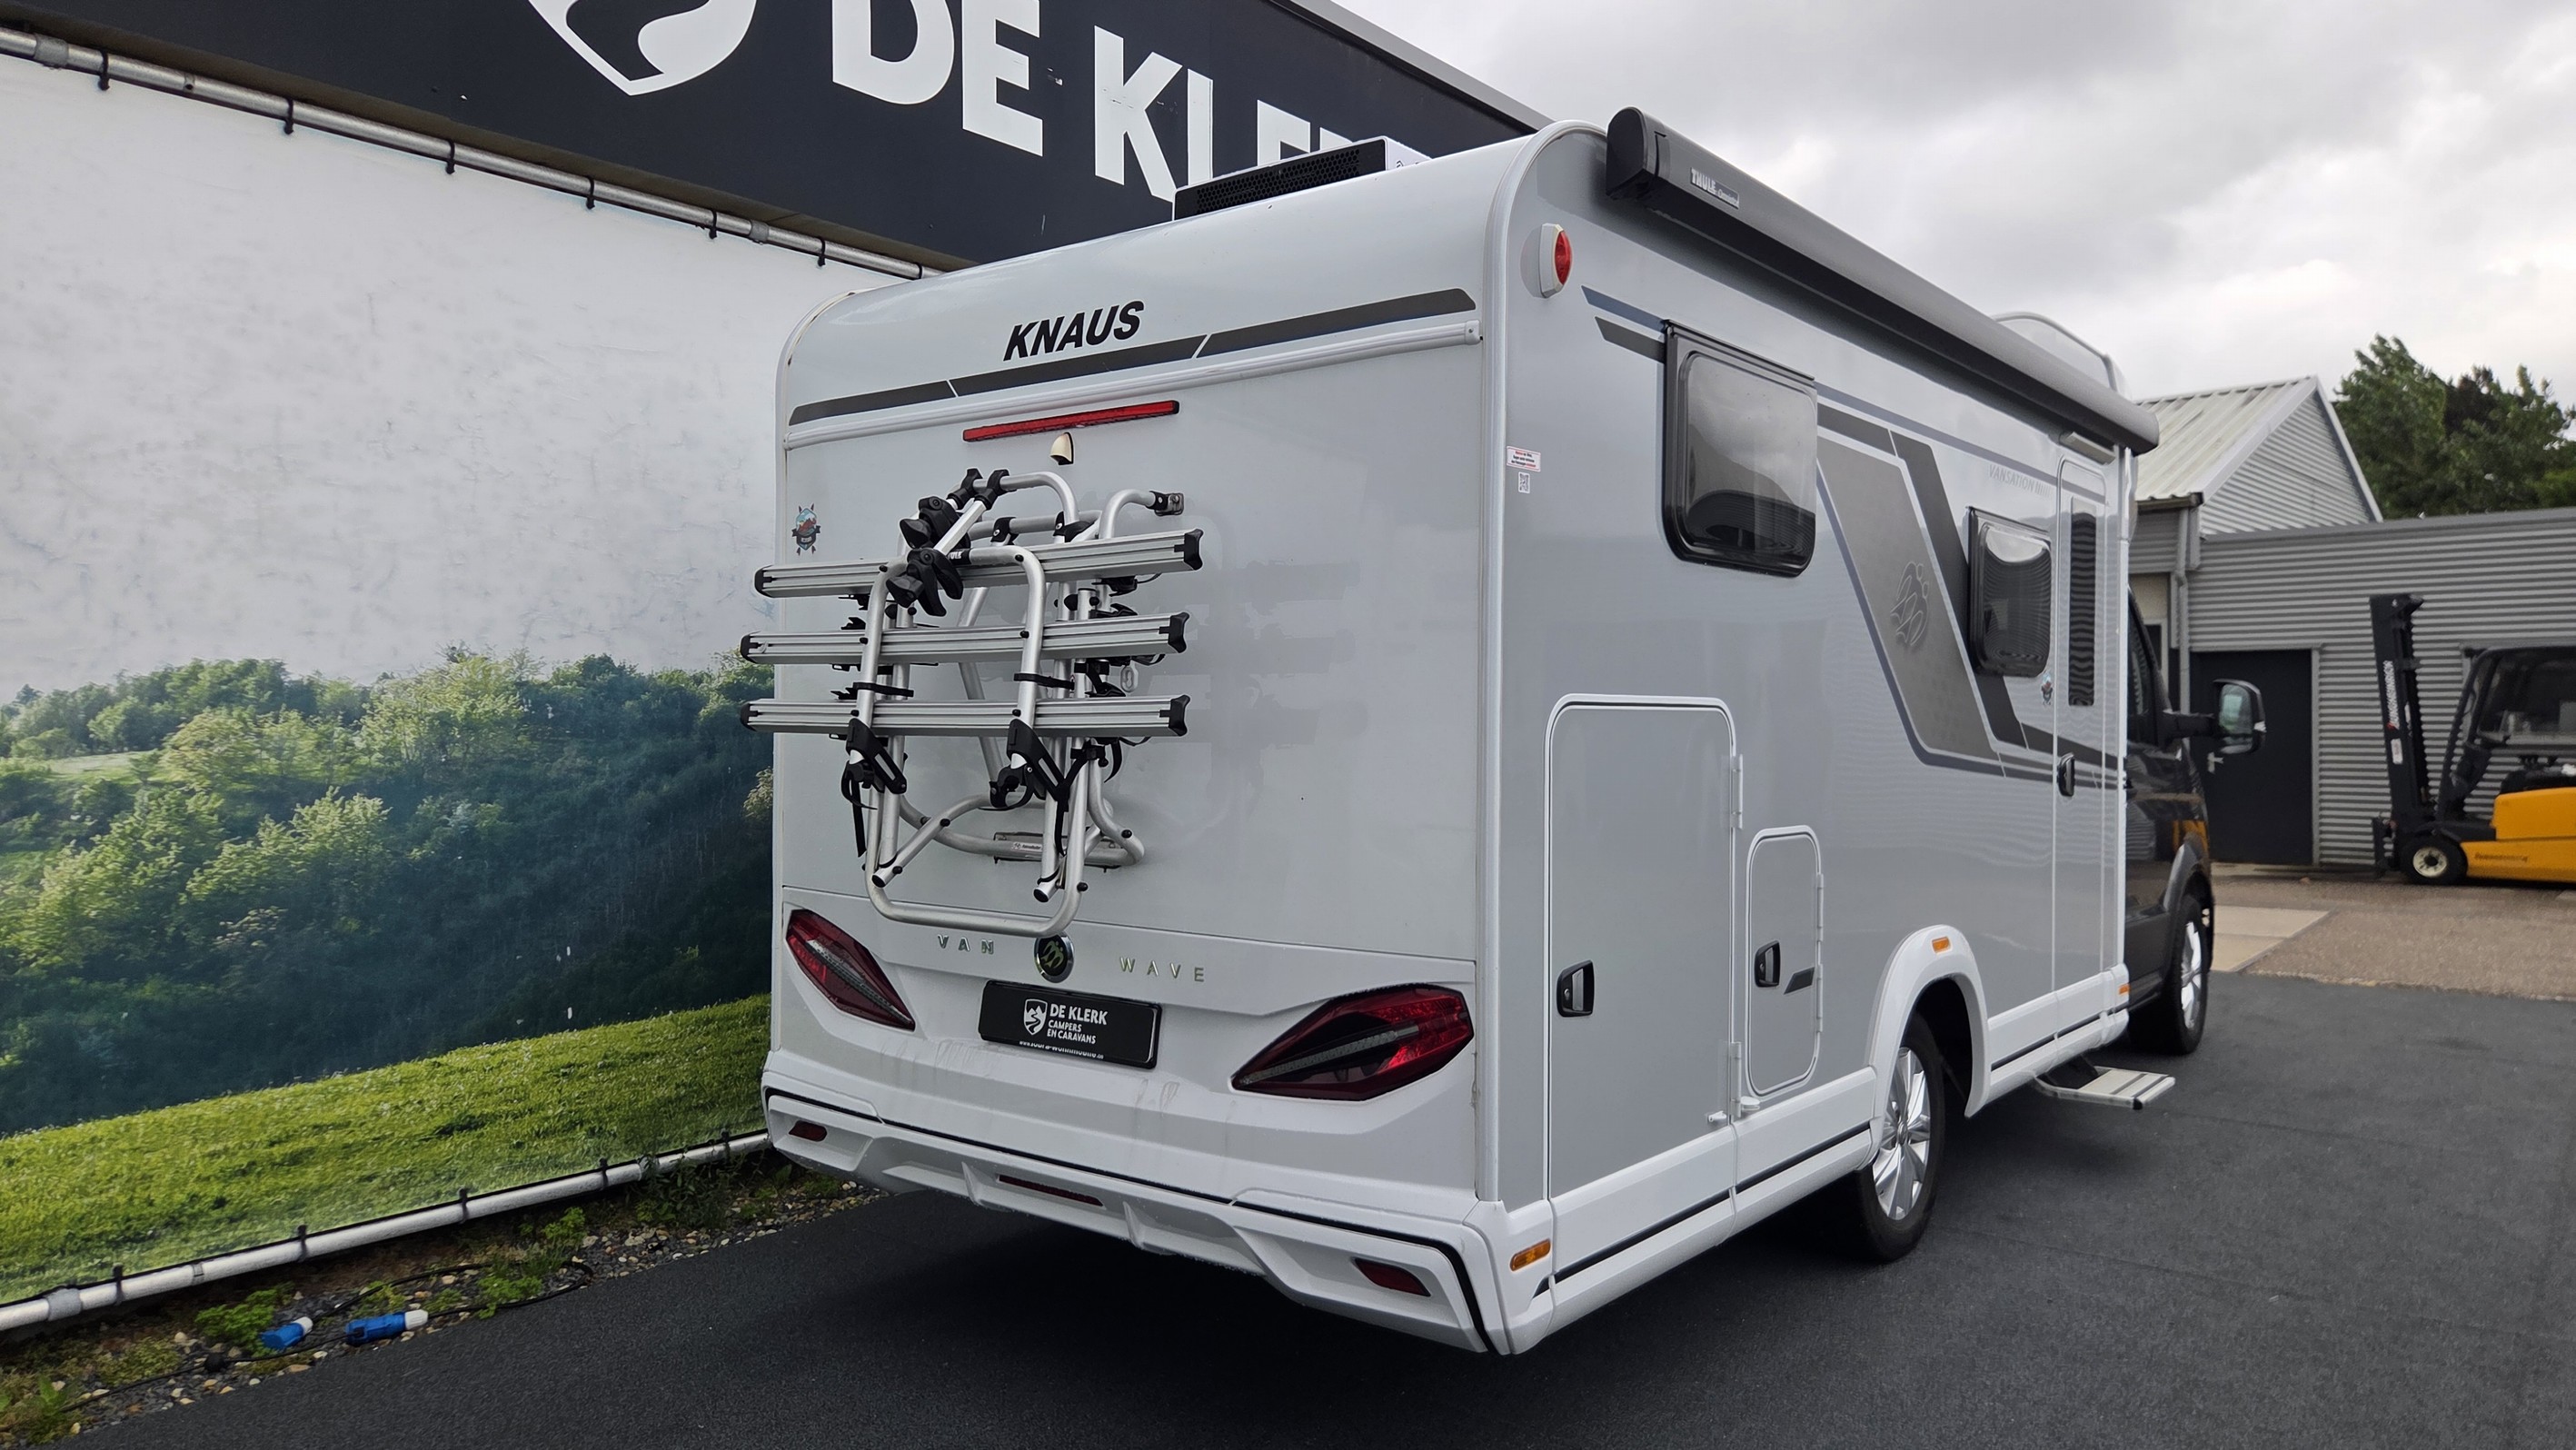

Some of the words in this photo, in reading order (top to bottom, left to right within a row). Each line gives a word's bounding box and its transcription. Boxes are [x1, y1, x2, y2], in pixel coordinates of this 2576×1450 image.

[832, 0, 1043, 157] DE
[1691, 167, 1716, 195] THULE
[1002, 300, 1145, 362] KNAUS
[1989, 463, 2035, 492] VANSATION
[938, 934, 994, 955] VAN
[1119, 957, 1205, 982] WAVE
[1048, 1019, 1082, 1032] CAMPERS
[1049, 1003, 1065, 1018] DE
[1068, 1006, 1108, 1025] KLERK
[1047, 1028, 1059, 1038] EN
[1058, 1030, 1097, 1045] CARAVANS
